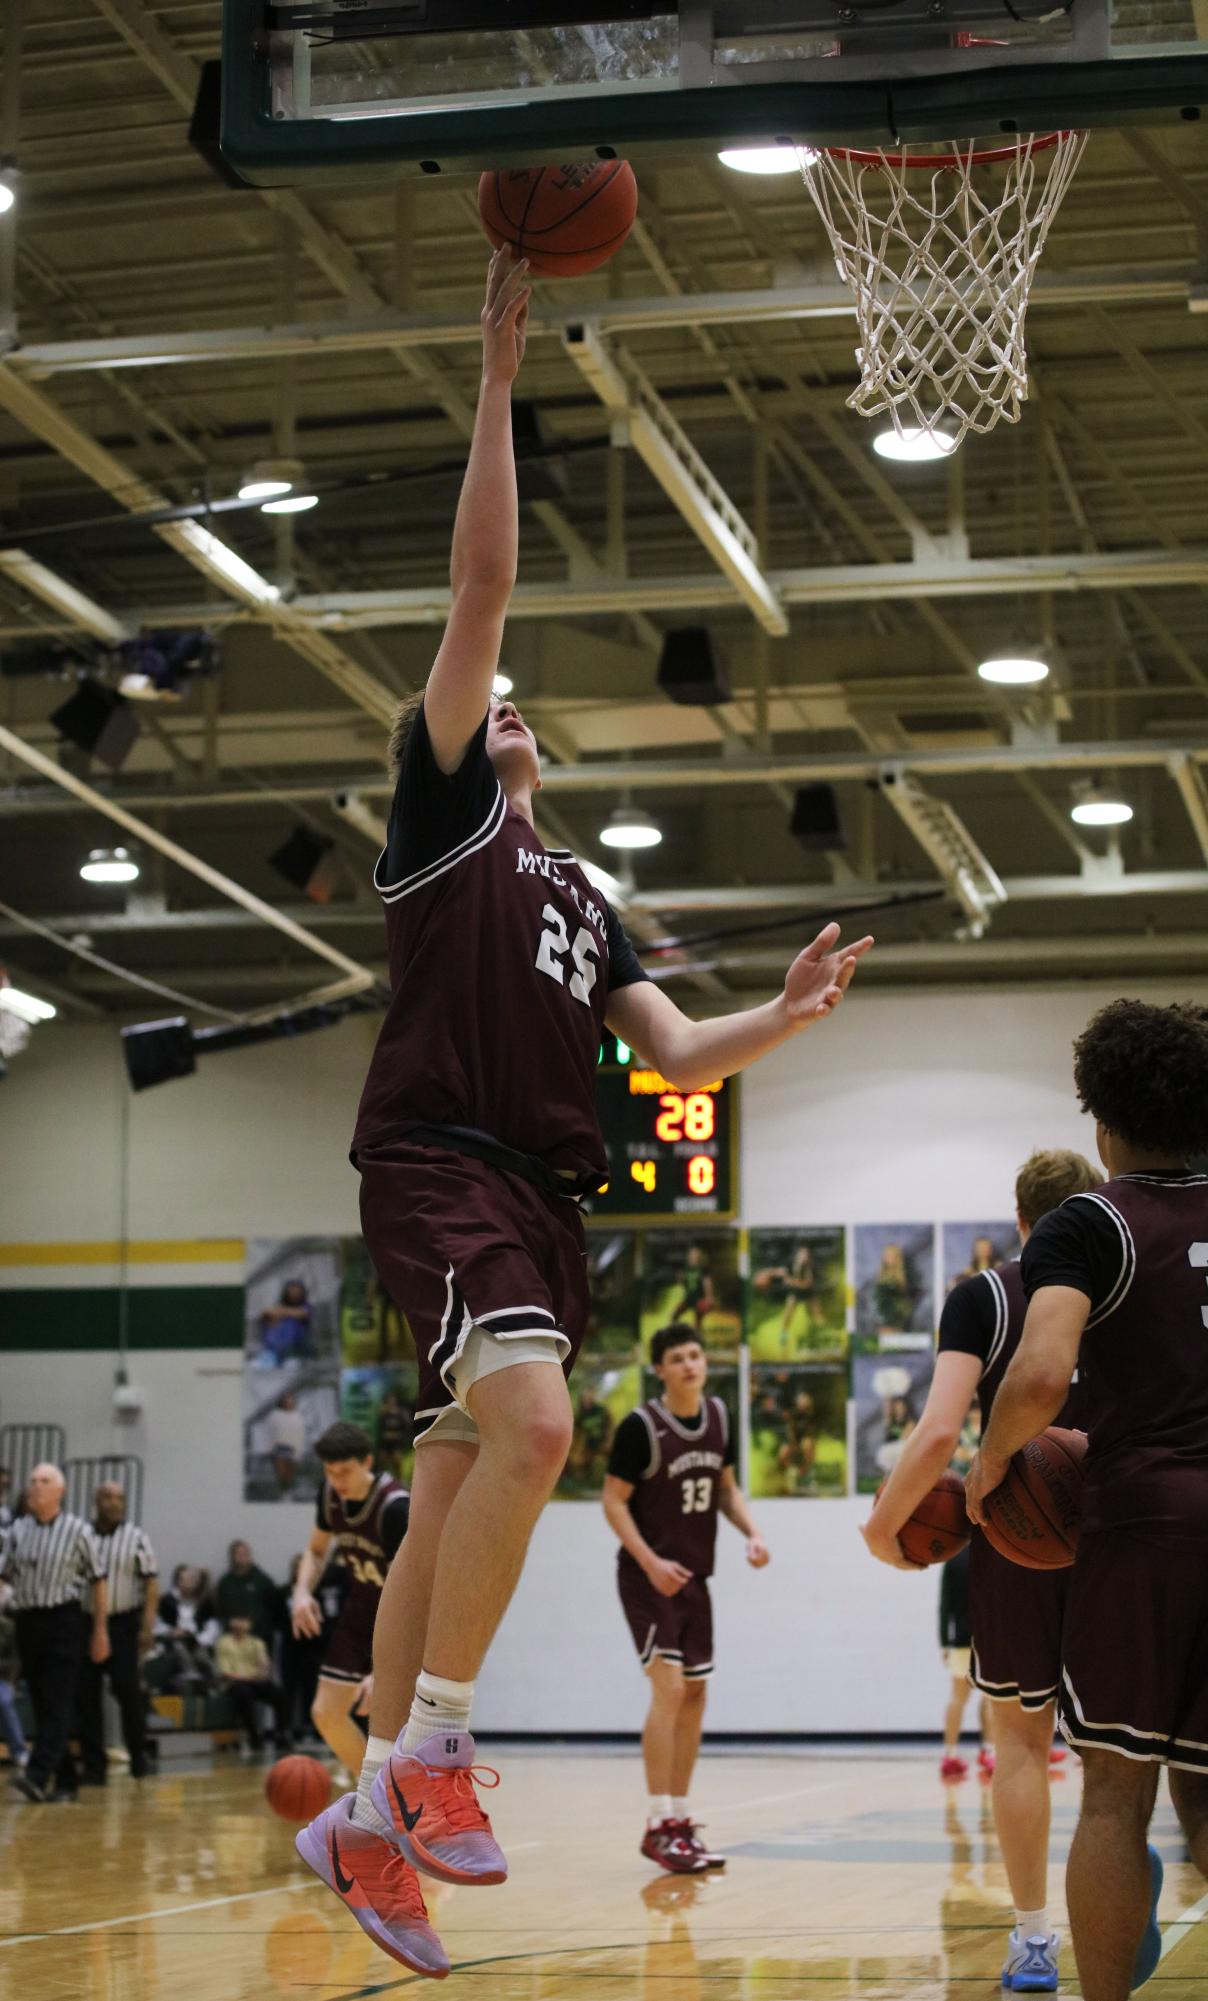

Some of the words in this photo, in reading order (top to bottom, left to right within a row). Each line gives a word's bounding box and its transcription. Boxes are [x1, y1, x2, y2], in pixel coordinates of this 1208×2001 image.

[535, 903, 600, 1008] 25
[656, 1093, 714, 1142] 28
[630, 1160, 657, 1193] 4
[688, 1155, 715, 1195] 0
[681, 1476, 713, 1514] 33
